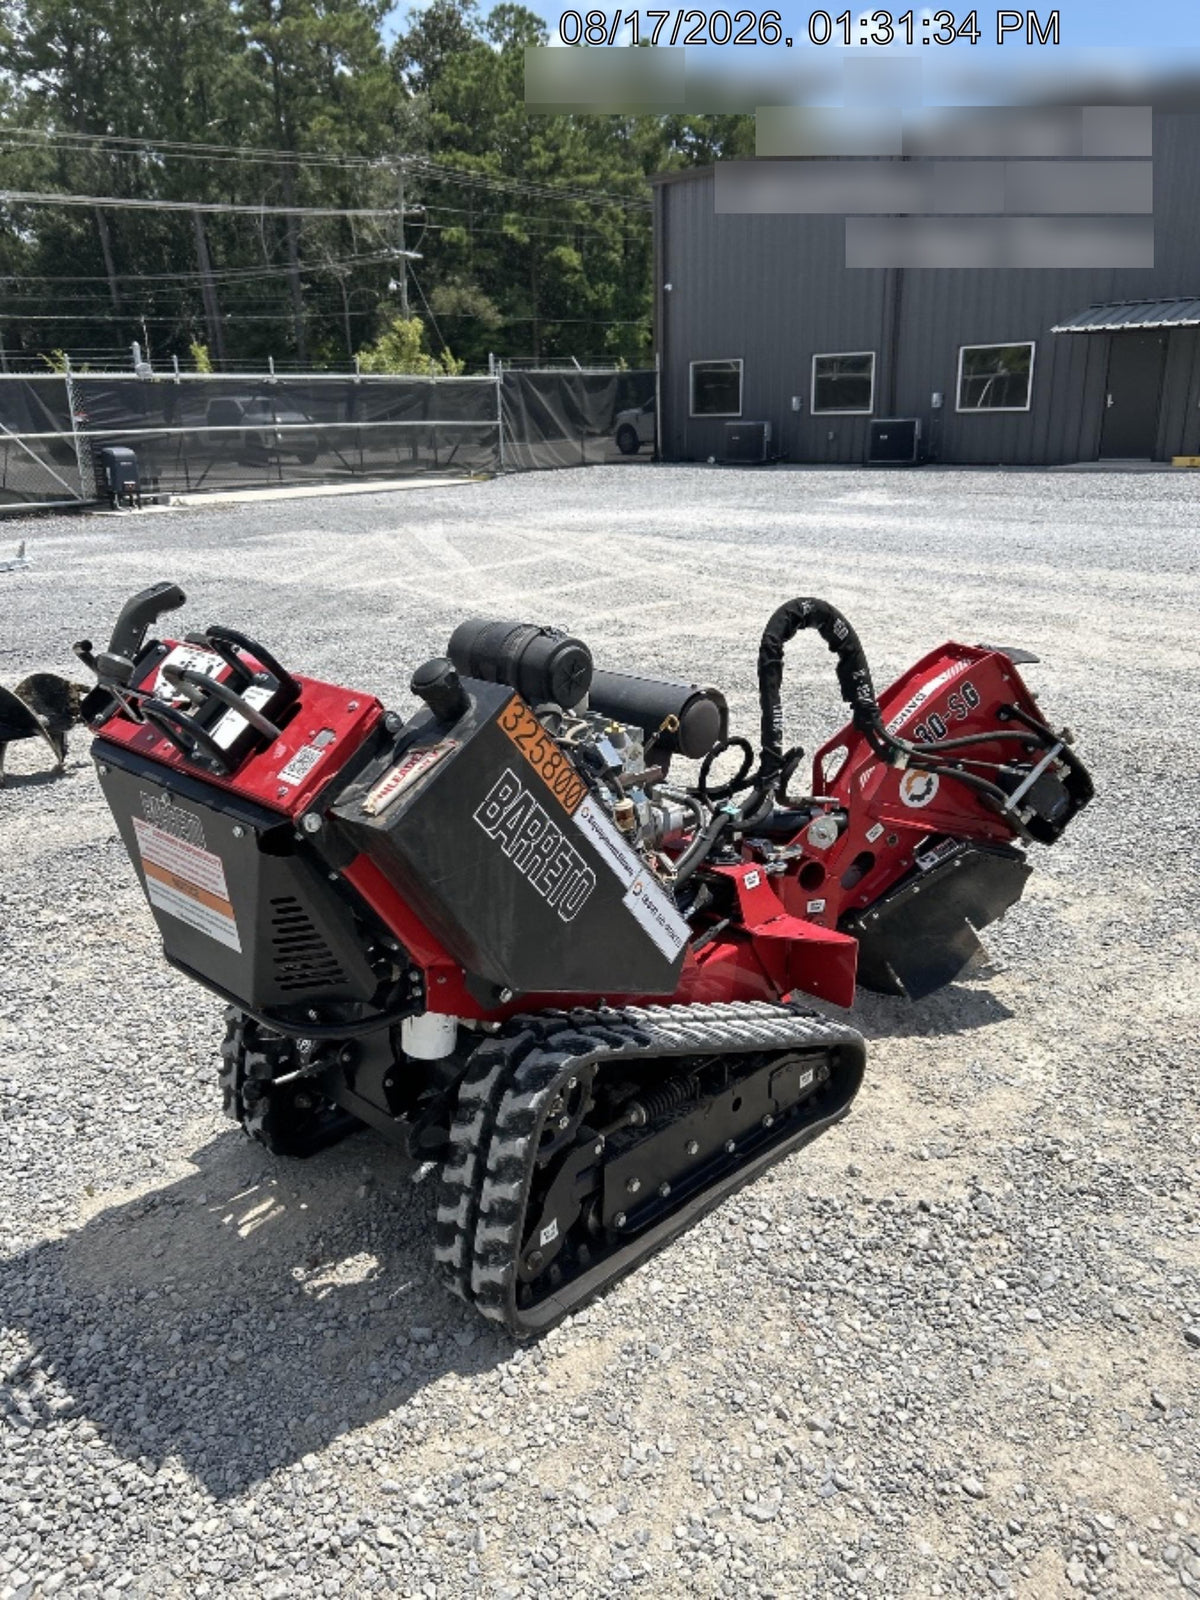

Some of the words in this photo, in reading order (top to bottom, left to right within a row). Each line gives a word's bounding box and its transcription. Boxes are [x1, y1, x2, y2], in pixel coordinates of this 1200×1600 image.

[502, 701, 587, 808] 325800
[914, 680, 981, 745] 30-SG
[472, 767, 597, 922] BARRETO
